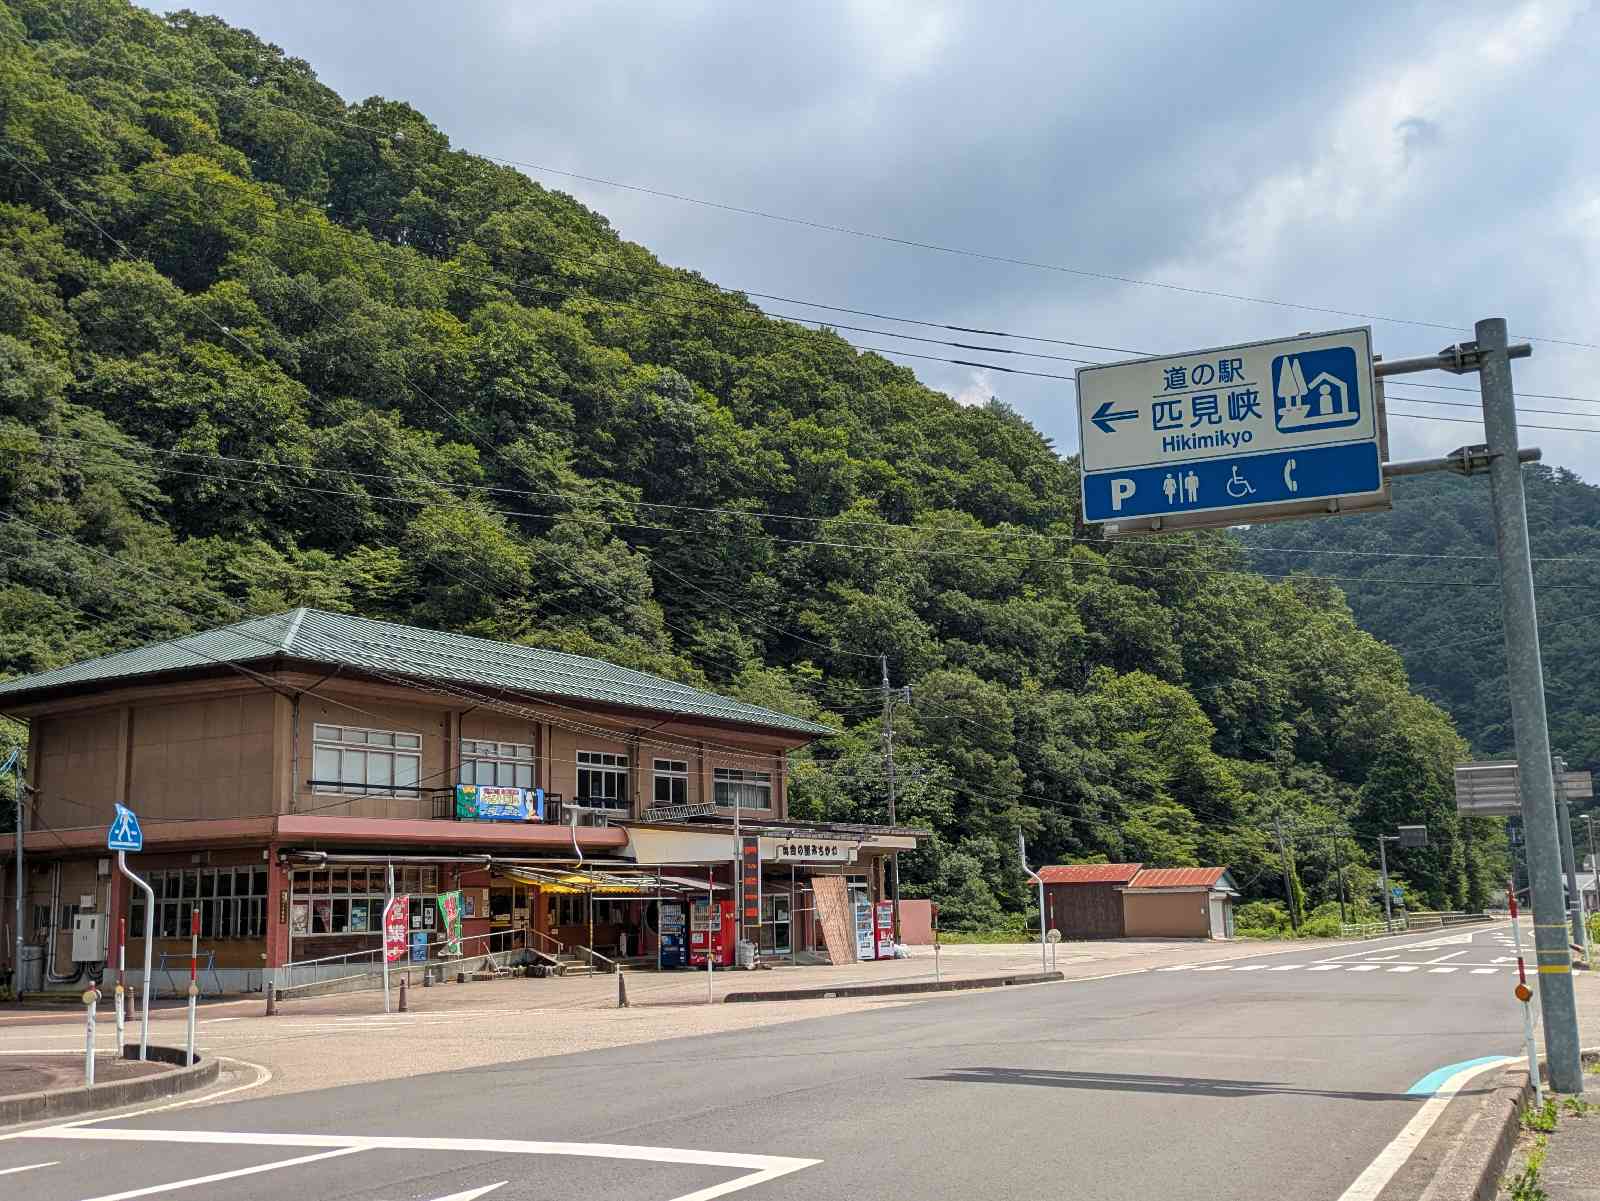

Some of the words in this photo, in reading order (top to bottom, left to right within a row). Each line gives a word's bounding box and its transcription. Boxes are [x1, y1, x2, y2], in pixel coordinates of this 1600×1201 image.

[1163, 358, 1245, 391] 道の駅
[1152, 388, 1263, 430] 匹見峡
[1162, 429, 1252, 452] Hikimikyo
[1111, 479, 1136, 511] P
